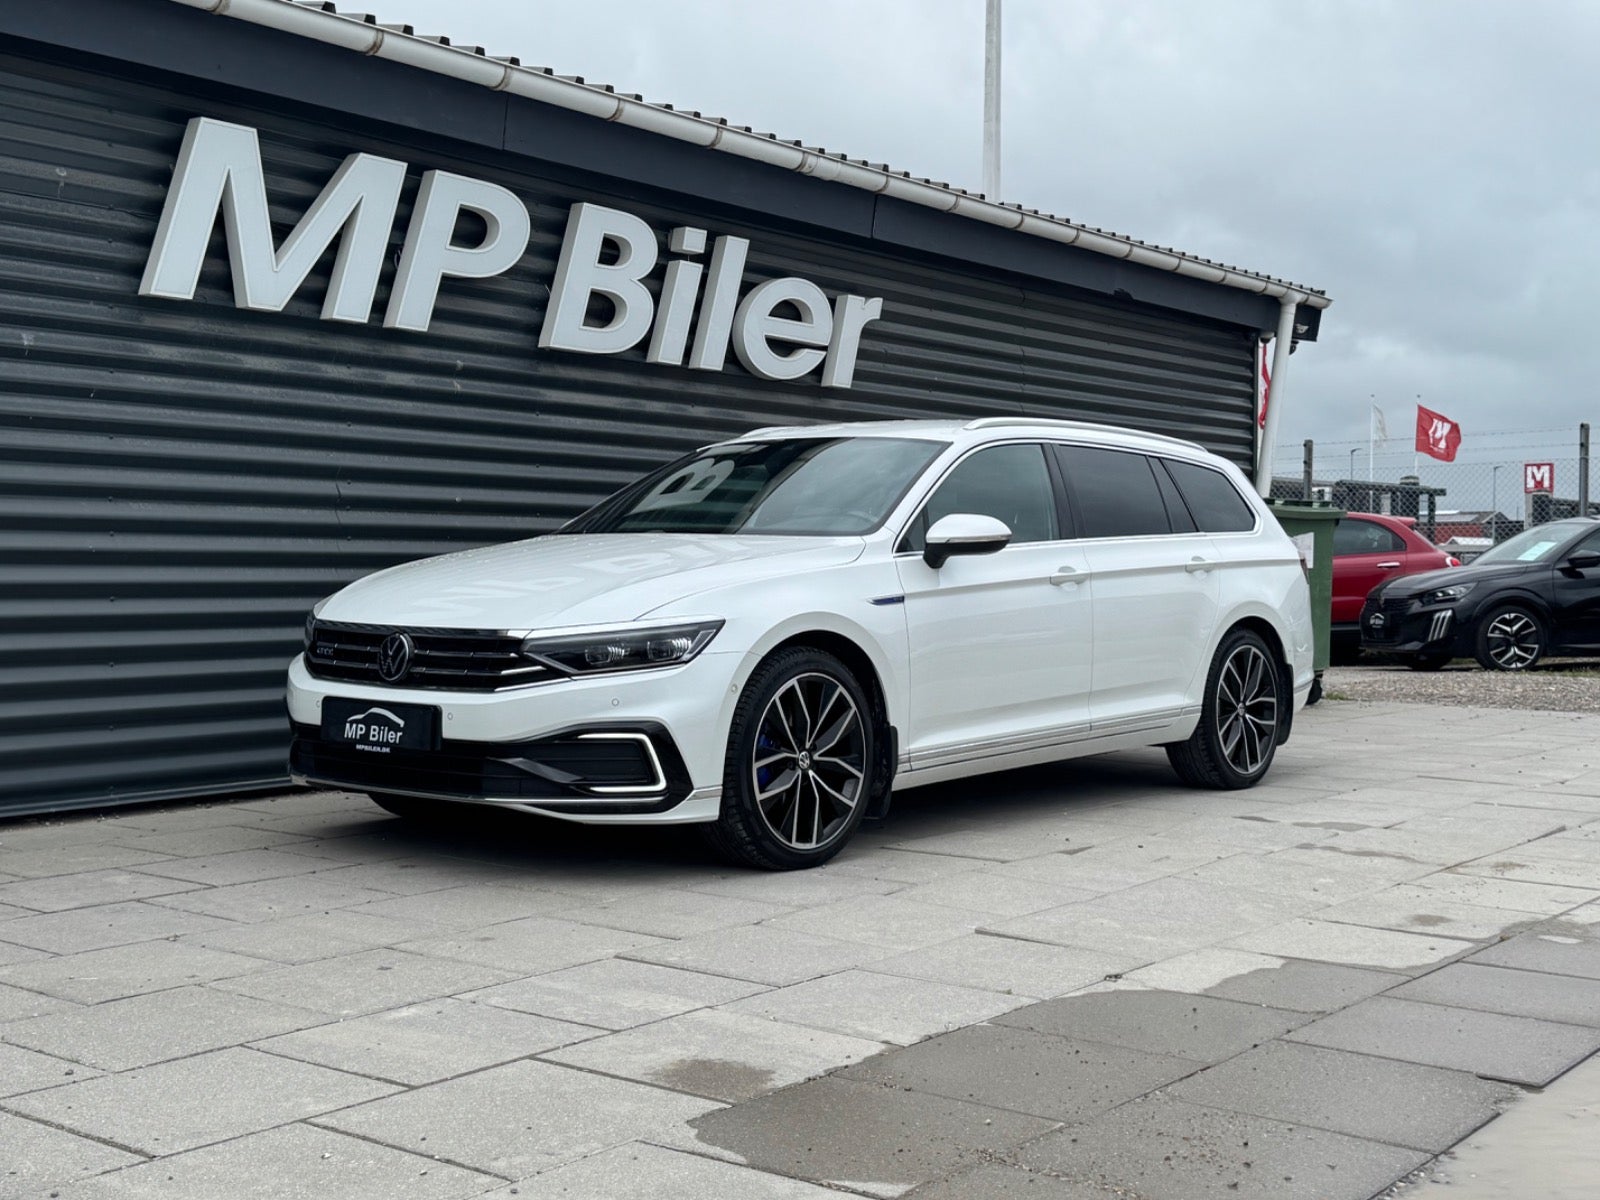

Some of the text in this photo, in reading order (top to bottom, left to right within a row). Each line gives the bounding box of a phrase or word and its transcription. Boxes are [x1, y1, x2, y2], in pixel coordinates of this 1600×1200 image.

[138, 116, 883, 389] MP Biler
[1526, 465, 1550, 488] M
[344, 723, 403, 744] MP Biler
